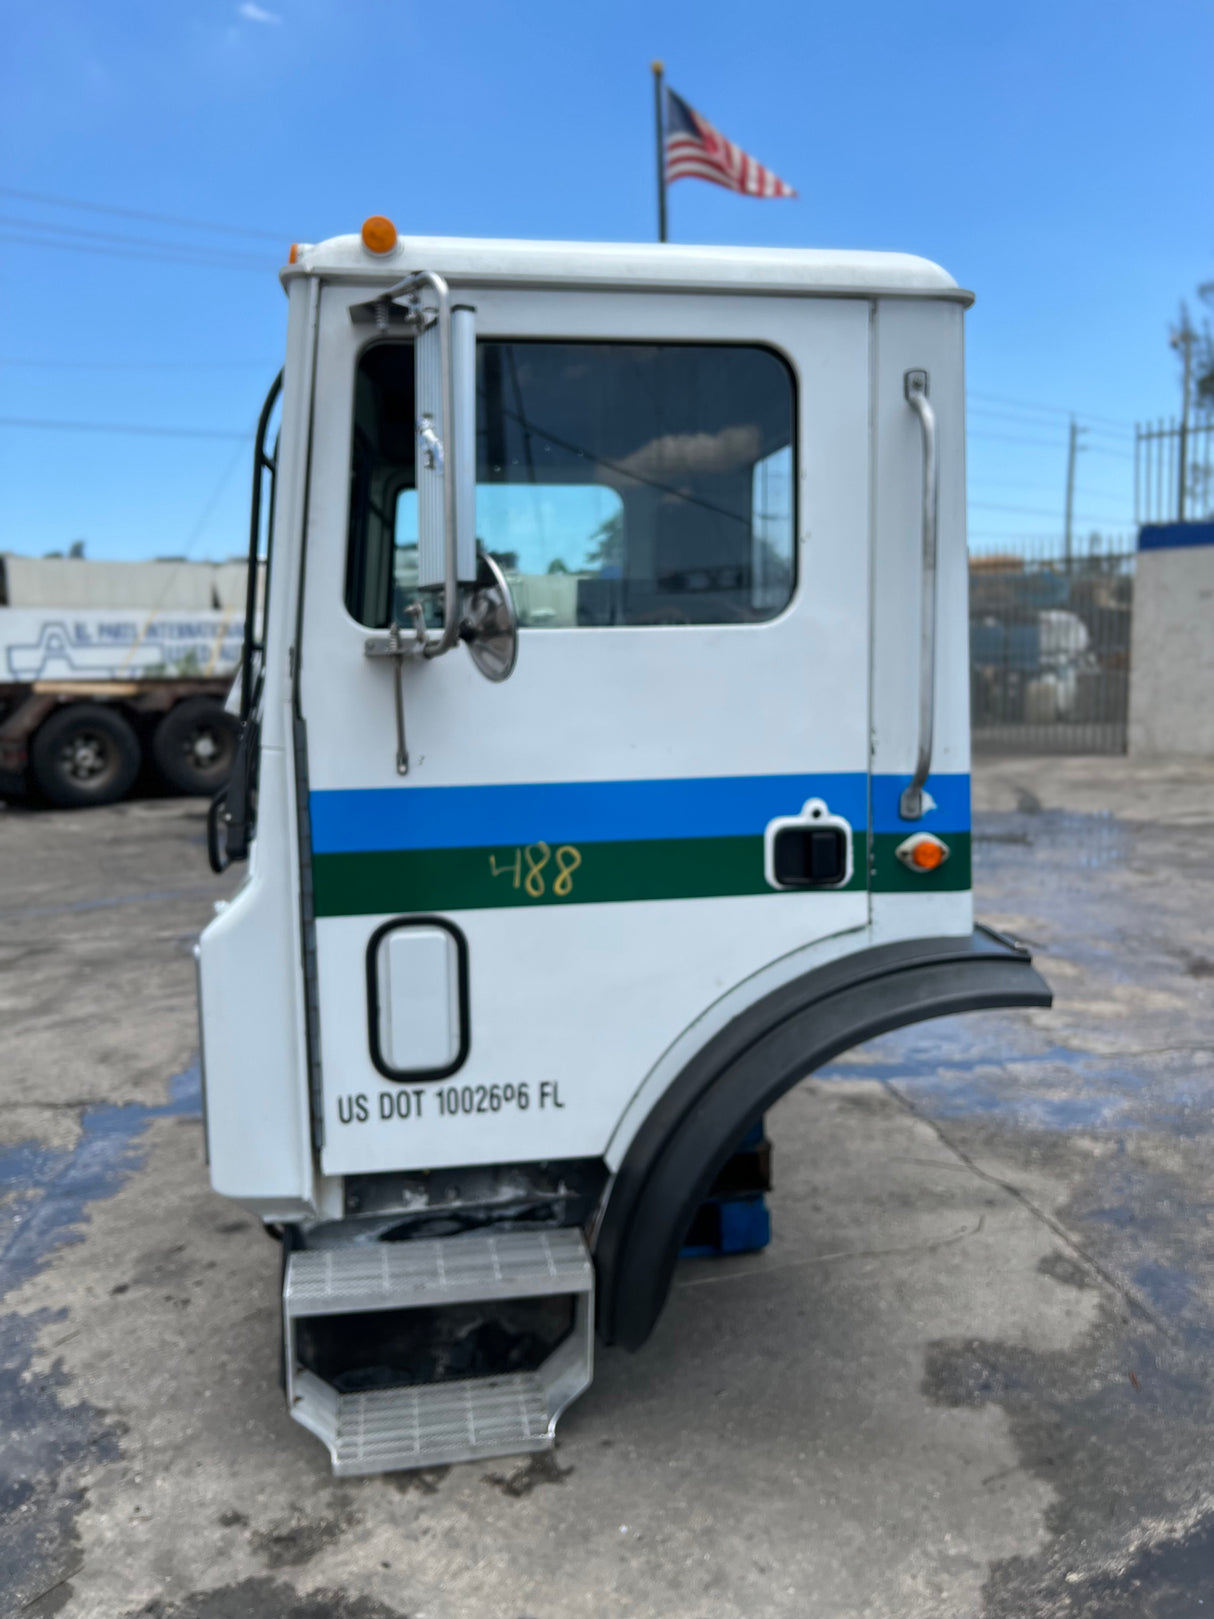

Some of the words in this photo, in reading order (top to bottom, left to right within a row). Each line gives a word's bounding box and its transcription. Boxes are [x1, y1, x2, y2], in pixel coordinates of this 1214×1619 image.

[489, 840, 582, 898] 488
[338, 1093, 369, 1124] US
[380, 1089, 425, 1120] DOT
[539, 1080, 566, 1109] FL
